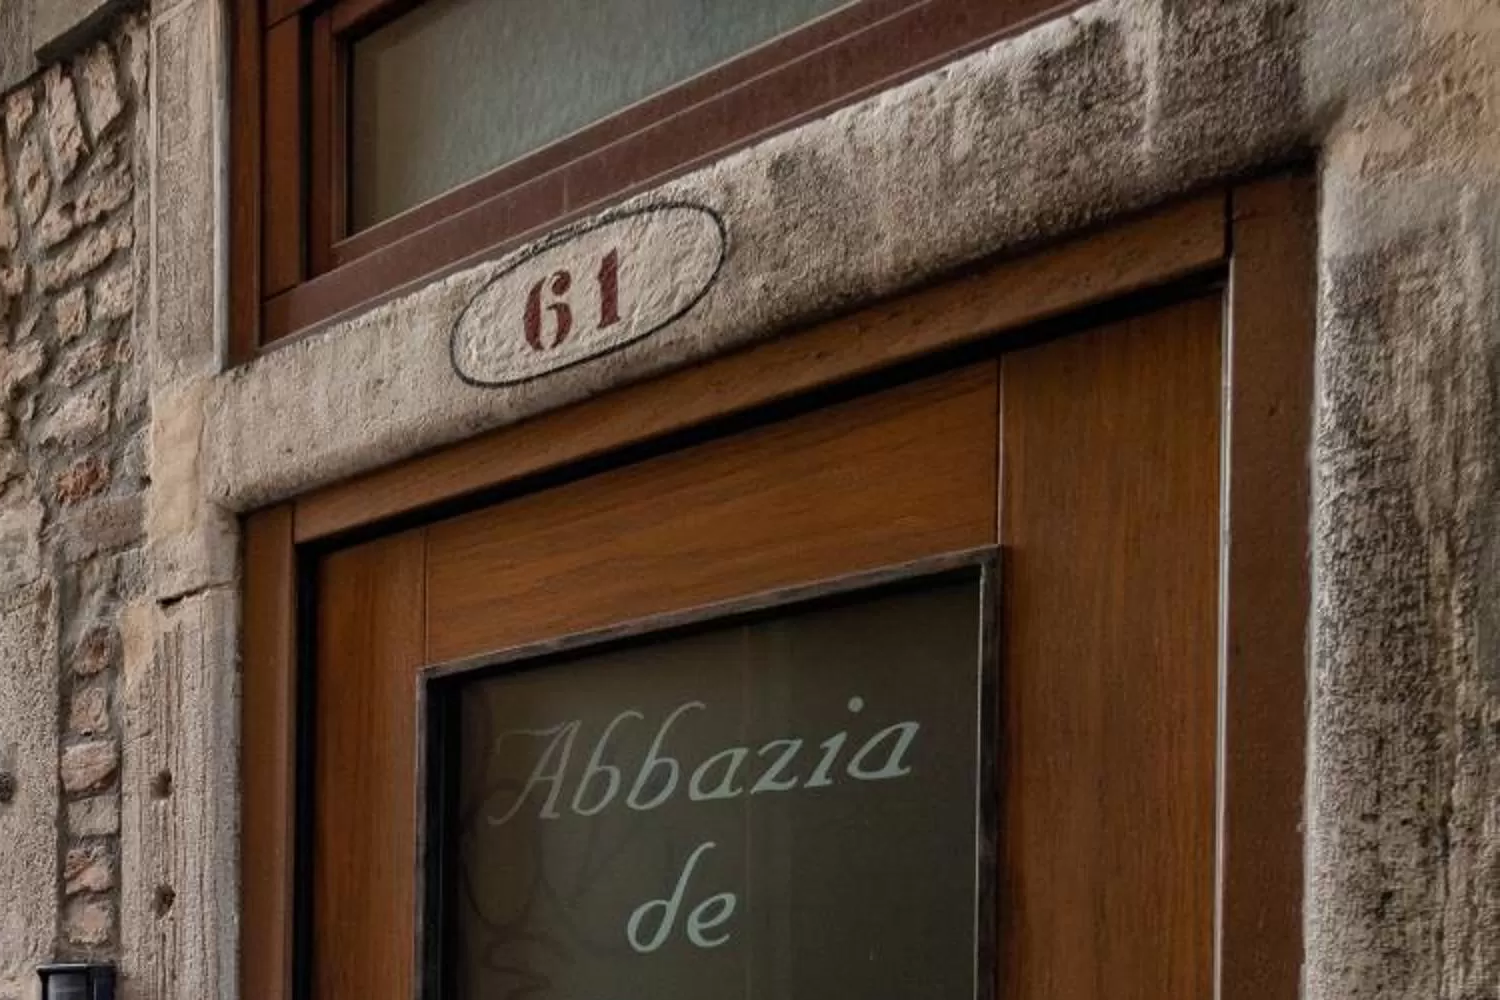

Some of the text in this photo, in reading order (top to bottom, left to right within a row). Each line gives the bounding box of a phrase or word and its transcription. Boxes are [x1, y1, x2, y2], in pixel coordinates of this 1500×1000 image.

[523, 247, 620, 350] 61
[488, 696, 920, 825] Abbazia
[627, 841, 737, 952] de
